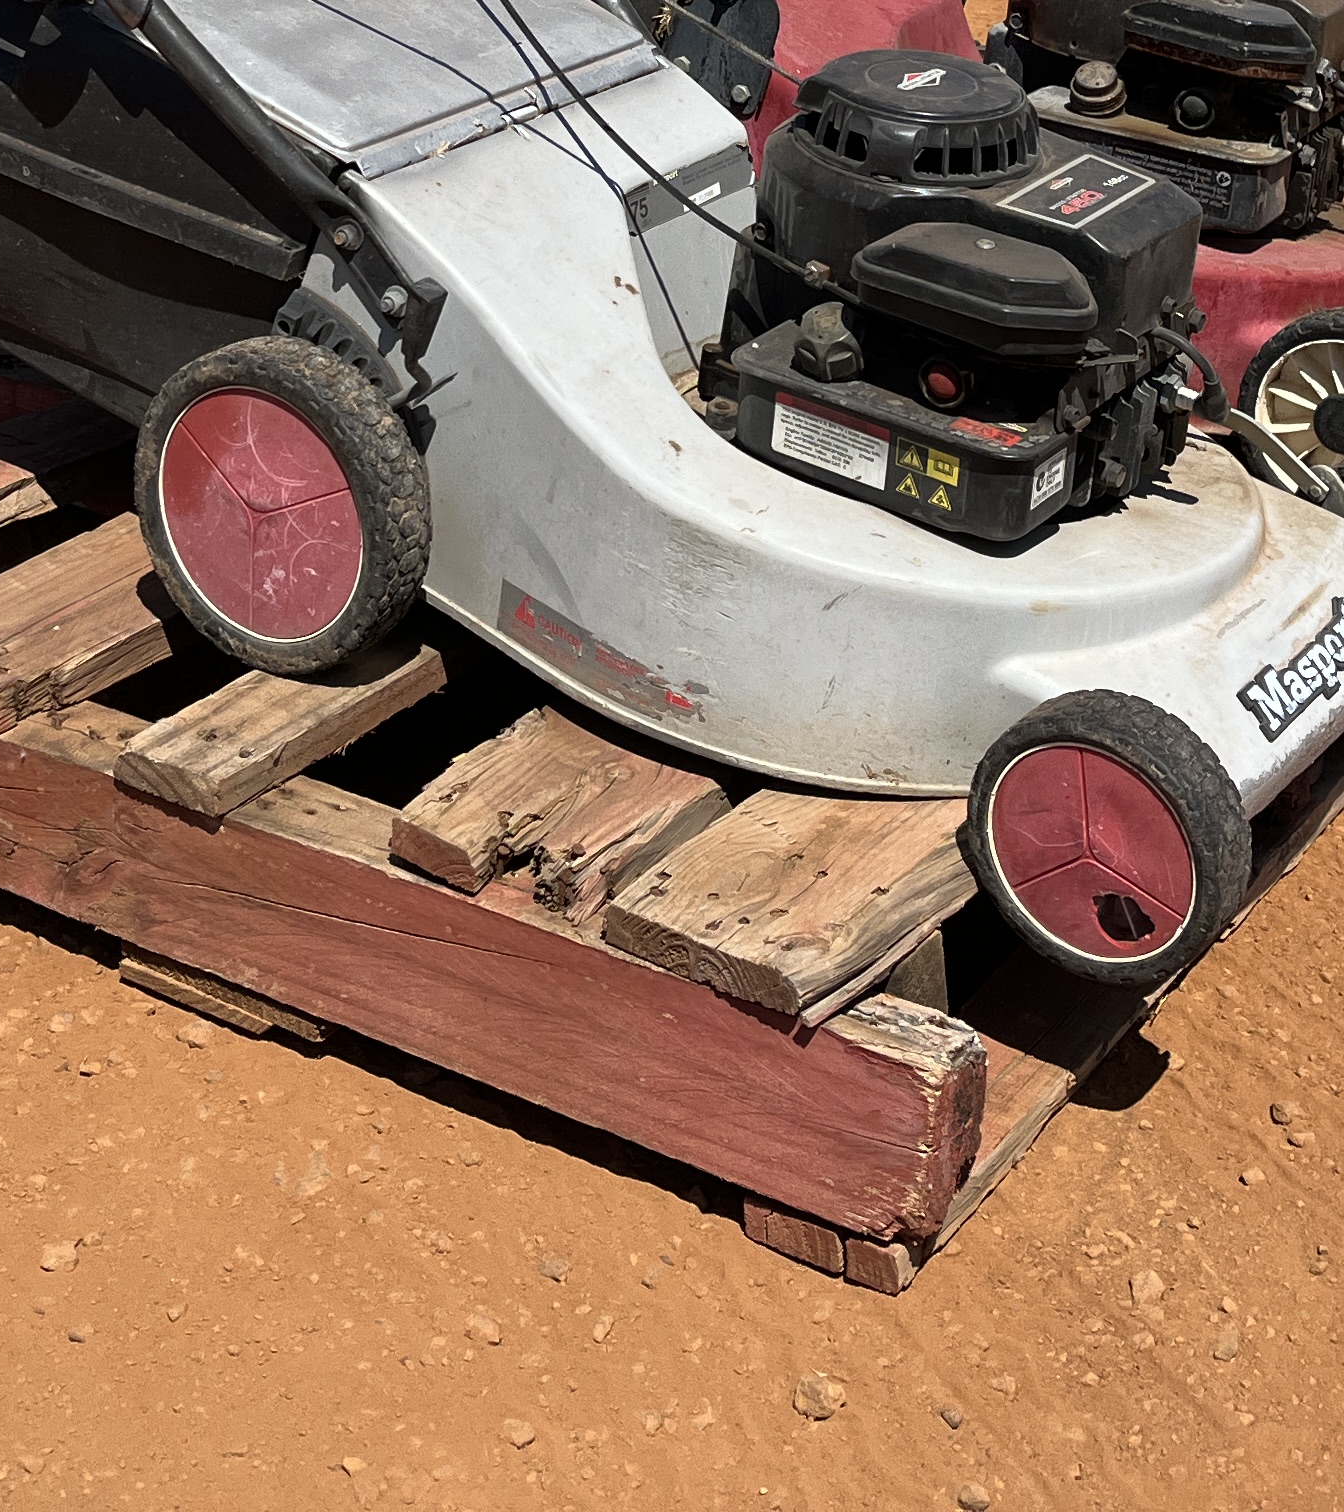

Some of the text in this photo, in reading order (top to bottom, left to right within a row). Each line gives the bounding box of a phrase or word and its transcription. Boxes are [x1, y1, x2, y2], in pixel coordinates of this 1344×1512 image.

[630, 196, 649, 218] 75
[1060, 190, 1106, 215] 450
[537, 614, 583, 651] CAUTION
